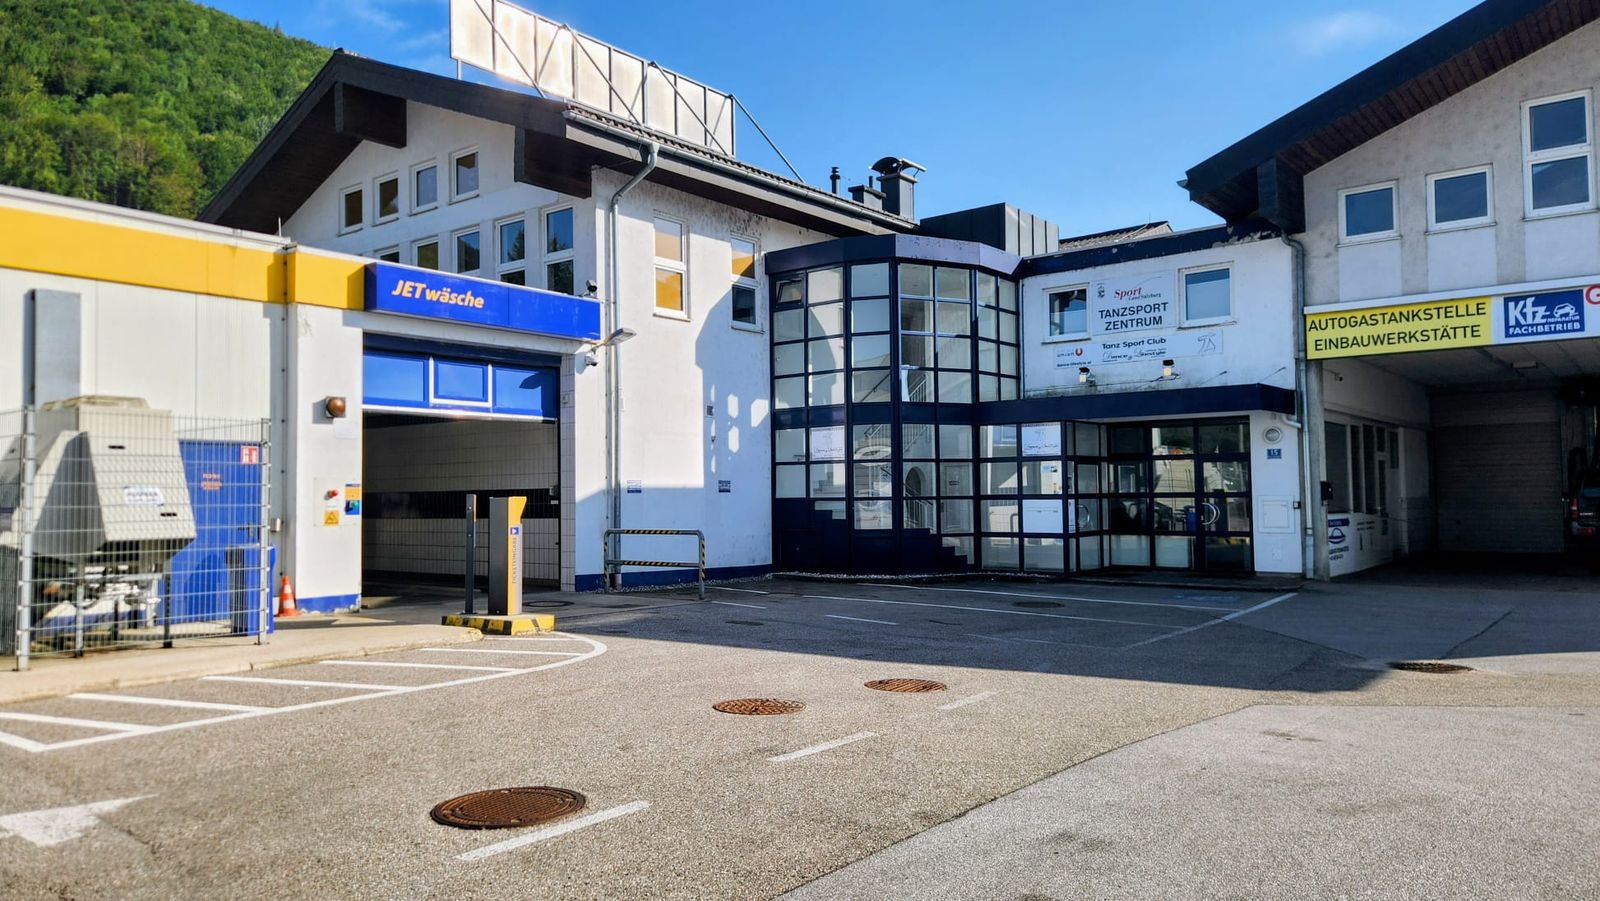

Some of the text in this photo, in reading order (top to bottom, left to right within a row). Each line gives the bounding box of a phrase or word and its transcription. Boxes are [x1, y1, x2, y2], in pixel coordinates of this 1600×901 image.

[1114, 287, 1142, 300] Sport
[1098, 302, 1169, 319] TANZSPORT
[1308, 302, 1486, 332] AUTOGASTANKSTELLE
[1508, 296, 1550, 326] Kfz
[1105, 316, 1163, 331] ZENTRUM
[1509, 322, 1581, 335] FACHBETRIEB
[1122, 340, 1145, 349] Sport
[1146, 337, 1166, 345] Club
[1314, 324, 1481, 351] EINBAUWERKSTÄTTE
